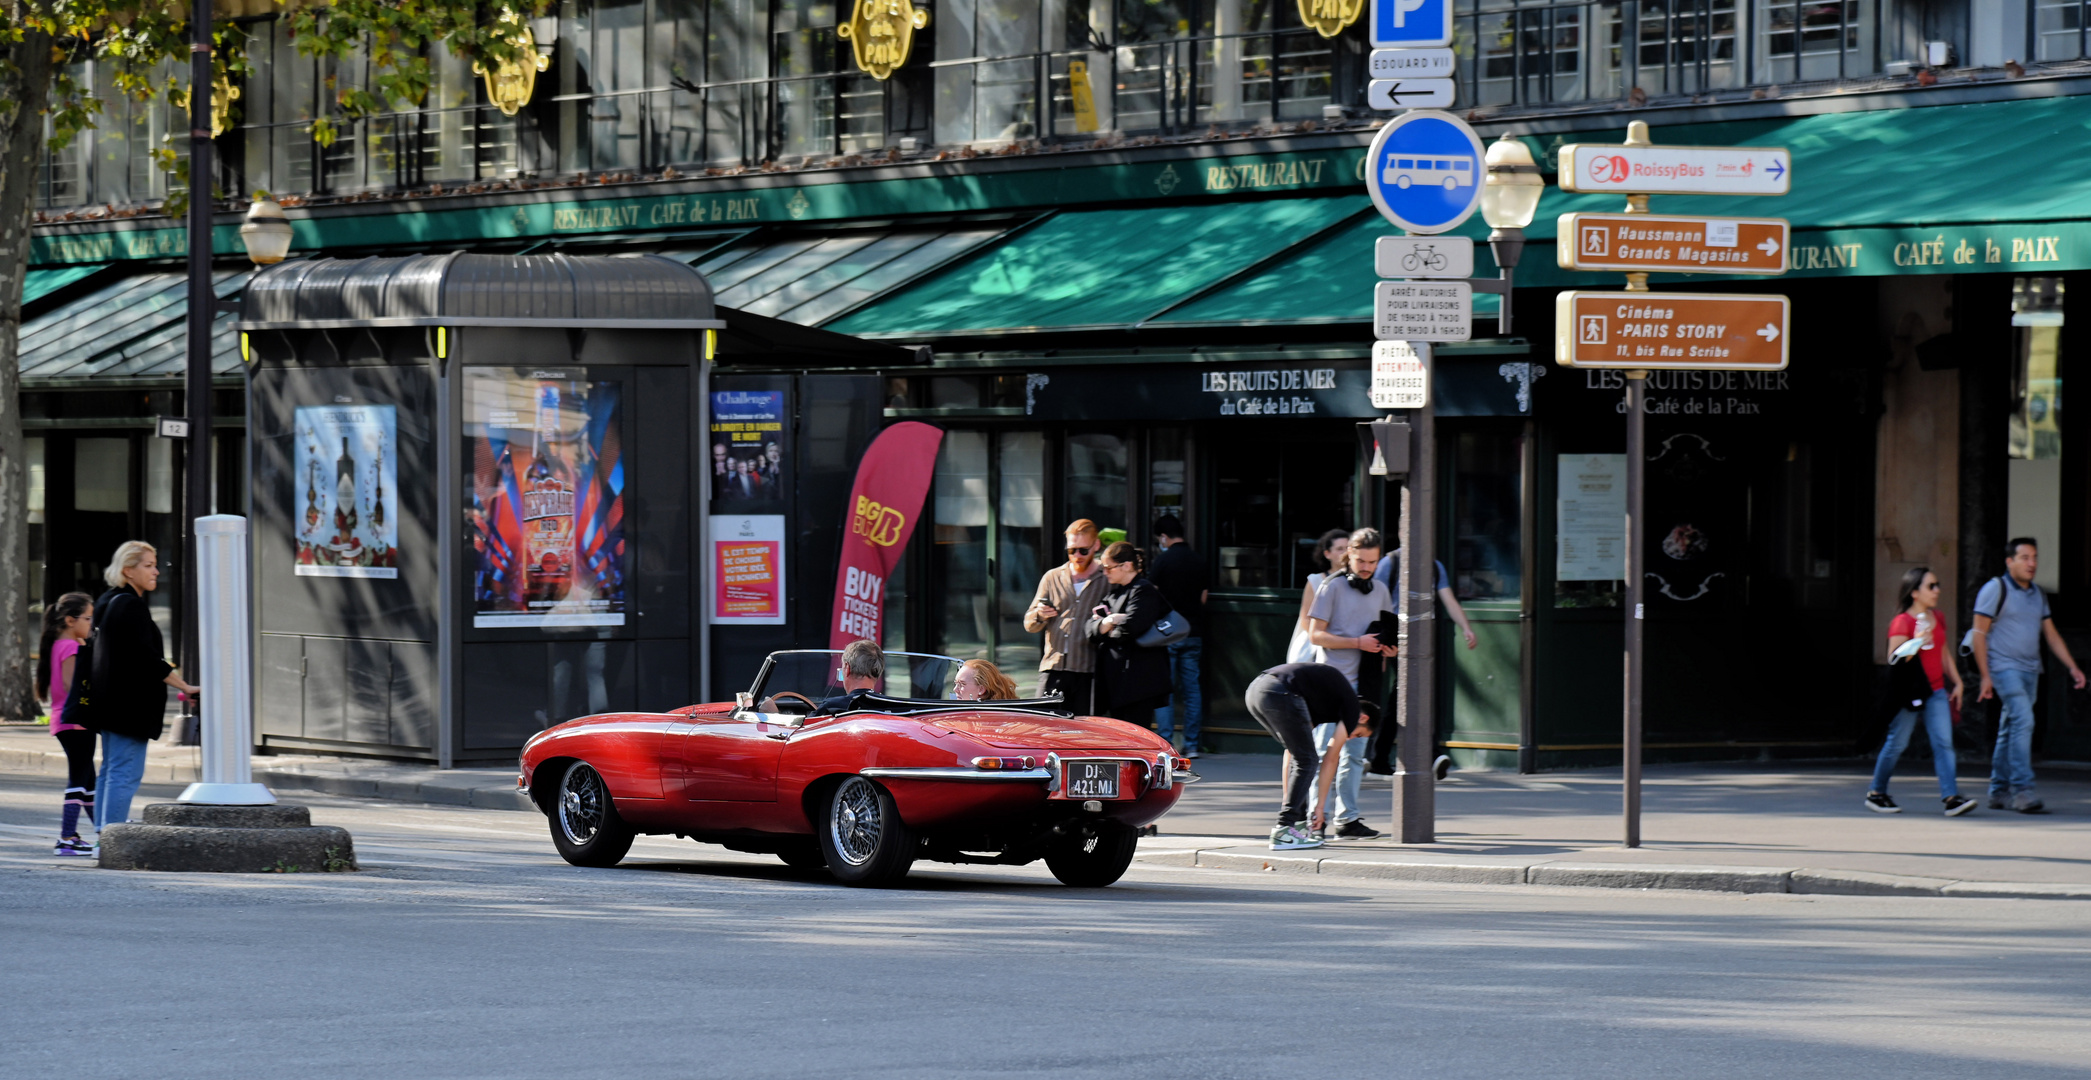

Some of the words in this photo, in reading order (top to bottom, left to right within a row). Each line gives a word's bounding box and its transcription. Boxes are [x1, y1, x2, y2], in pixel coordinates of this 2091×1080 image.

[1393, 0, 1426, 28] P
[865, 37, 900, 64] PAIX
[1374, 58, 1428, 70] EDOUARD
[1432, 57, 1449, 68] VII
[1205, 159, 1326, 190] RESTAURANT
[1633, 163, 1705, 180] RoissyBus
[553, 205, 641, 230] RESTAURANT
[651, 197, 686, 224] CAFÉ
[690, 200, 706, 222] de
[710, 200, 722, 221] la
[726, 198, 760, 220] PAIX
[1617, 226, 1702, 242] Haussmann
[1618, 245, 1671, 260] Grands
[1677, 247, 1750, 265] Magasins
[1893, 234, 1945, 266] CAFÉ
[1953, 239, 1976, 265] de
[1984, 238, 2001, 264] la
[2010, 236, 2060, 263] PAIX
[1419, 288, 1458, 298] AUTORISÉ
[1386, 301, 1408, 309] POUR
[1411, 301, 1460, 310] LIVRAISONS
[1616, 305, 1674, 320] Cinéma
[1387, 313, 1398, 322] DE
[1381, 326, 1391, 334] ET
[1393, 326, 1404, 335] DE
[1407, 325, 1429, 335] 9H30
[1617, 324, 1669, 338] -PARIS
[1676, 325, 1726, 339] STORY
[1381, 345, 1418, 358] PIÉTONS
[1636, 344, 1655, 356] bis
[1660, 345, 1684, 358] Rue
[1689, 346, 1730, 358] Scribe
[1376, 362, 1424, 373] ATTENTION
[1202, 372, 1228, 392] LES
[1229, 371, 1280, 391] FRUITS
[1281, 370, 1302, 390] DE
[1303, 369, 1336, 389] MER
[1376, 378, 1423, 388] TRAVERSEZ
[1587, 370, 1624, 389] LES
[1645, 371, 1704, 390] RUITS
[1709, 371, 1739, 390] DE
[1744, 371, 1789, 390] MER
[1220, 399, 1236, 415] du
[1237, 397, 1263, 415] Café
[1263, 397, 1278, 414] de
[1279, 397, 1290, 414] la
[1292, 396, 1315, 414] Paix
[1375, 394, 1386, 403] EN
[1389, 394, 1393, 403] 2
[1396, 394, 1423, 403] TEMPS
[1642, 398, 1680, 414] Café
[1684, 398, 1703, 414] de
[1708, 398, 1722, 414] la
[1727, 398, 1760, 414] Paix
[169, 425, 181, 433] 12
[721, 423, 745, 431] DROITE
[746, 423, 755, 431] EN
[756, 423, 781, 431] DANGER
[732, 433, 742, 441] DE
[743, 433, 761, 441] MORT
[747, 547, 769, 555] TEMPS
[845, 566, 882, 603] BUY
[844, 596, 878, 619] TICKETS
[840, 612, 877, 641] HERE
[1085, 764, 1098, 778] DJ
